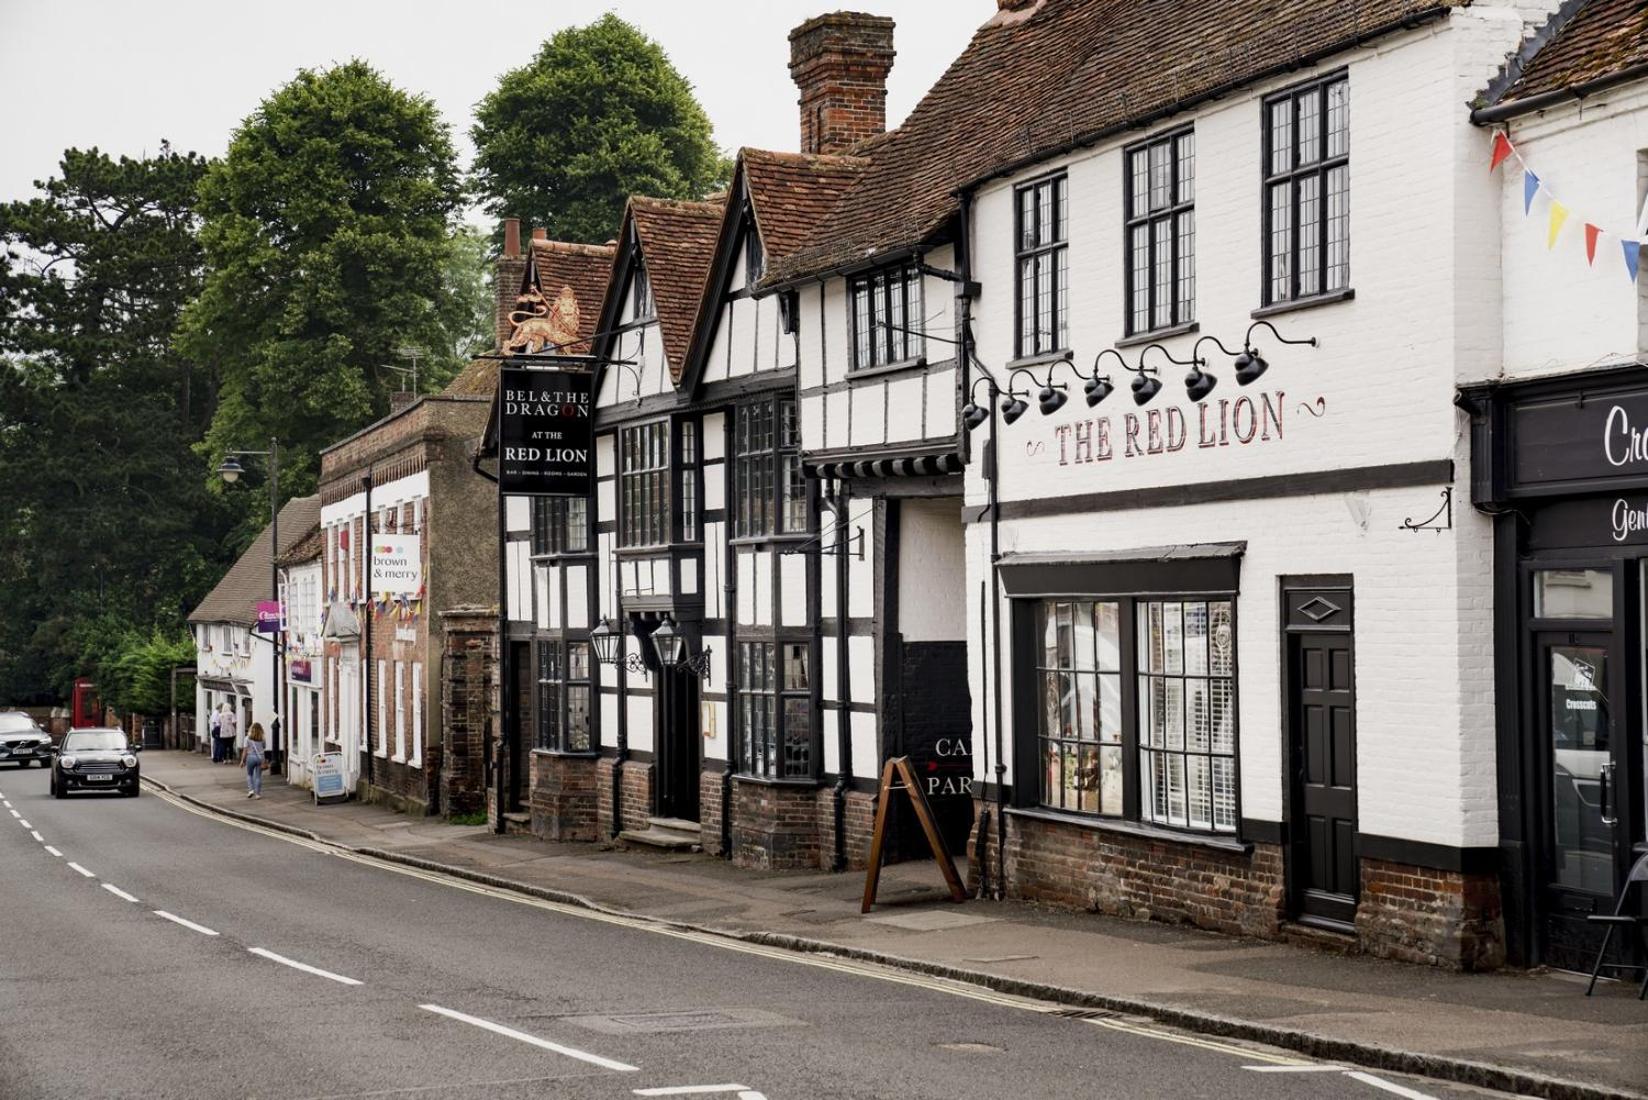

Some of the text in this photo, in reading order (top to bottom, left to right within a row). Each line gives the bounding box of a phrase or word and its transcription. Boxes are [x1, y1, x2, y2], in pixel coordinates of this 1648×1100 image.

[505, 403, 588, 417] DRAGON
[1054, 389, 1286, 466] THE RED LION
[532, 431, 563, 440] AT THE
[505, 447, 588, 463] RED LION
[373, 556, 408, 566] brown
[373, 568, 418, 581] & merry
[935, 738, 973, 757] CA
[927, 776, 973, 795] PAR
